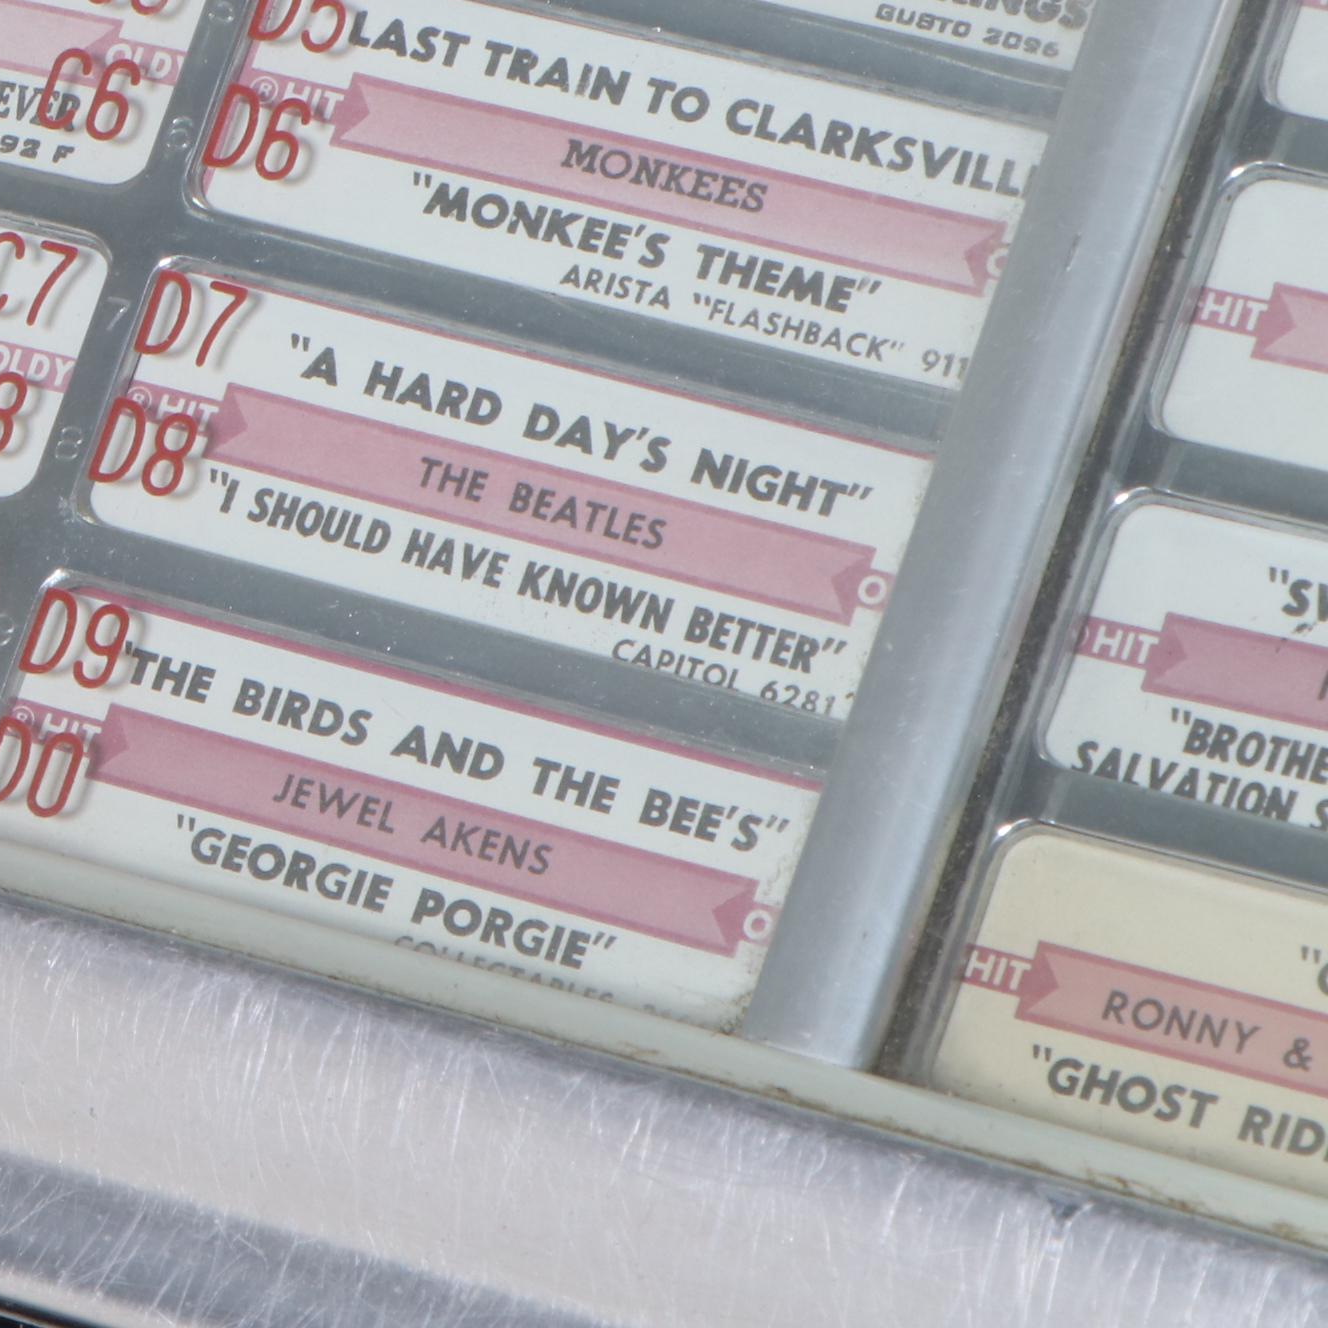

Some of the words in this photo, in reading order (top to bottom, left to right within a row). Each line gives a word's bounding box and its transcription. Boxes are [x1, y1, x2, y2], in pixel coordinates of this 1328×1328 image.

[52, 145, 75, 163] F
[560, 138, 768, 212] MONKEES
[413, 171, 670, 268] "MONKEE'S
[697, 244, 881, 313] THEME"
[136, 270, 246, 365] D7
[291, 333, 337, 386] "A
[363, 360, 502, 425] HARD
[522, 403, 670, 472] DAY'S
[690, 447, 873, 516] NIGHT"
[420, 456, 489, 502] THE
[508, 481, 667, 549] BEATLES
[20, 589, 128, 688] D9
[272, 774, 394, 834] JEWEL
[420, 816, 552, 875] AKENS
[177, 814, 393, 912] "GEORGIE
[410, 887, 616, 969] PORGIE"
[1101, 989, 1259, 1053] RONNY
[1282, 1037, 1312, 1071] &
[1033, 1044, 1218, 1128] "GHOST
